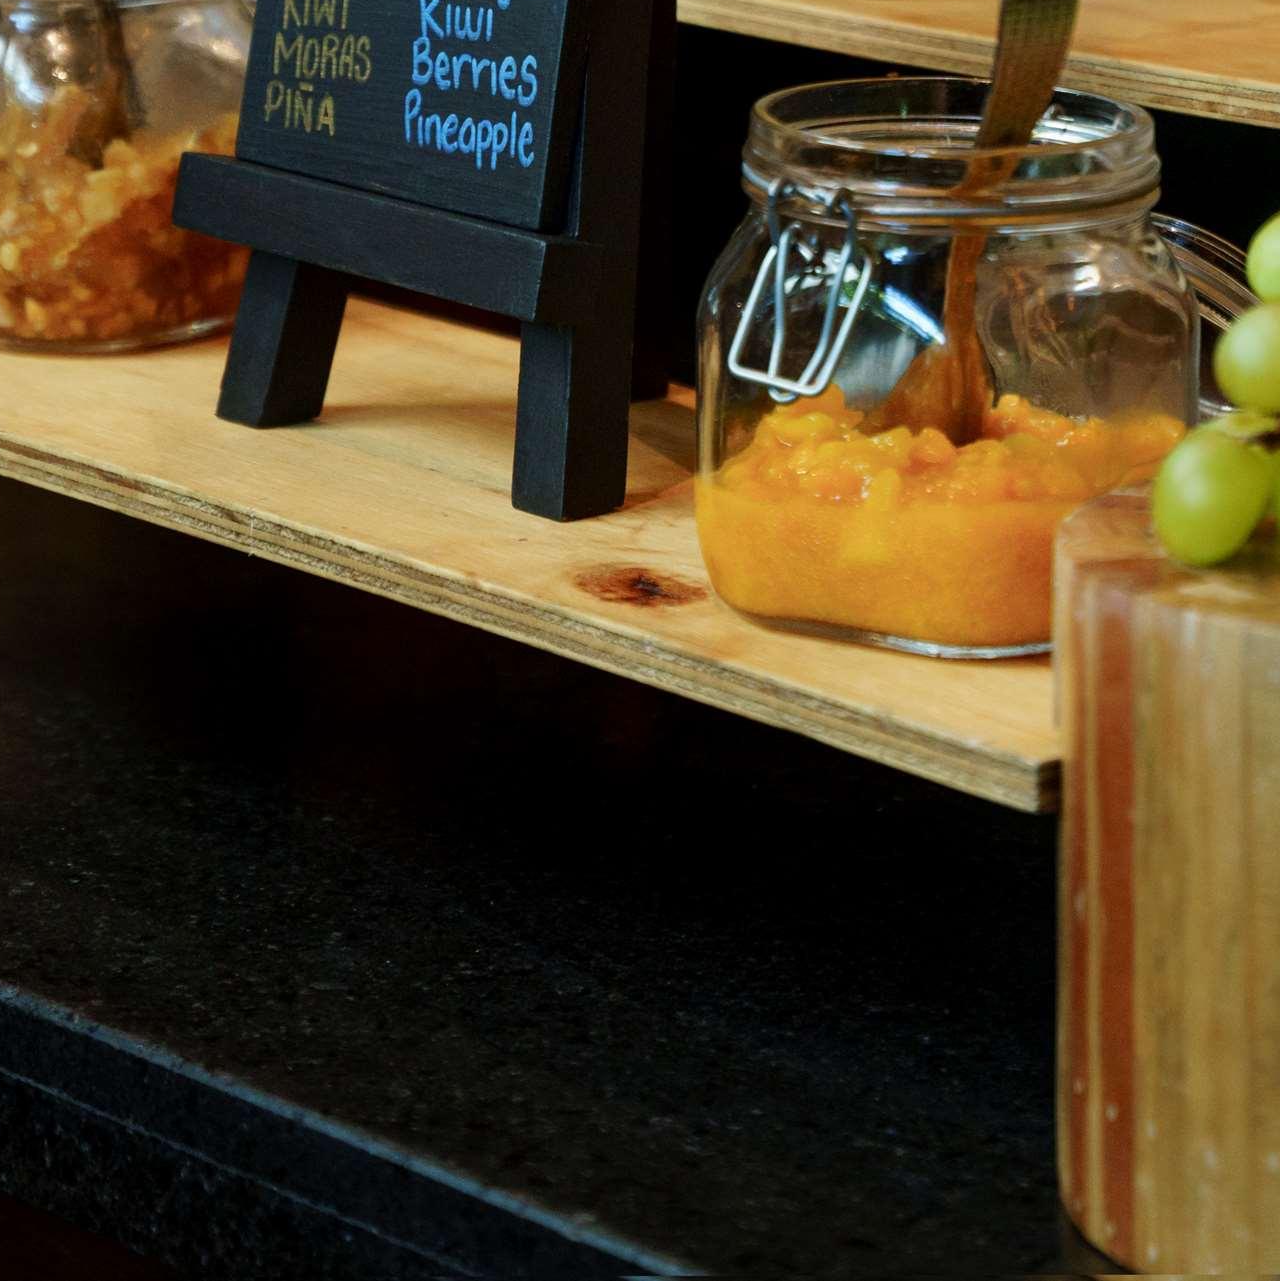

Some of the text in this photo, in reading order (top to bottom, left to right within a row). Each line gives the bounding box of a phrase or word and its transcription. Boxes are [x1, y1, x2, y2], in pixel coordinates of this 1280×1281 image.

[273, 33, 371, 81] MORAS
[411, 36, 538, 106] Berries
[404, 88, 535, 170] Pineapple
